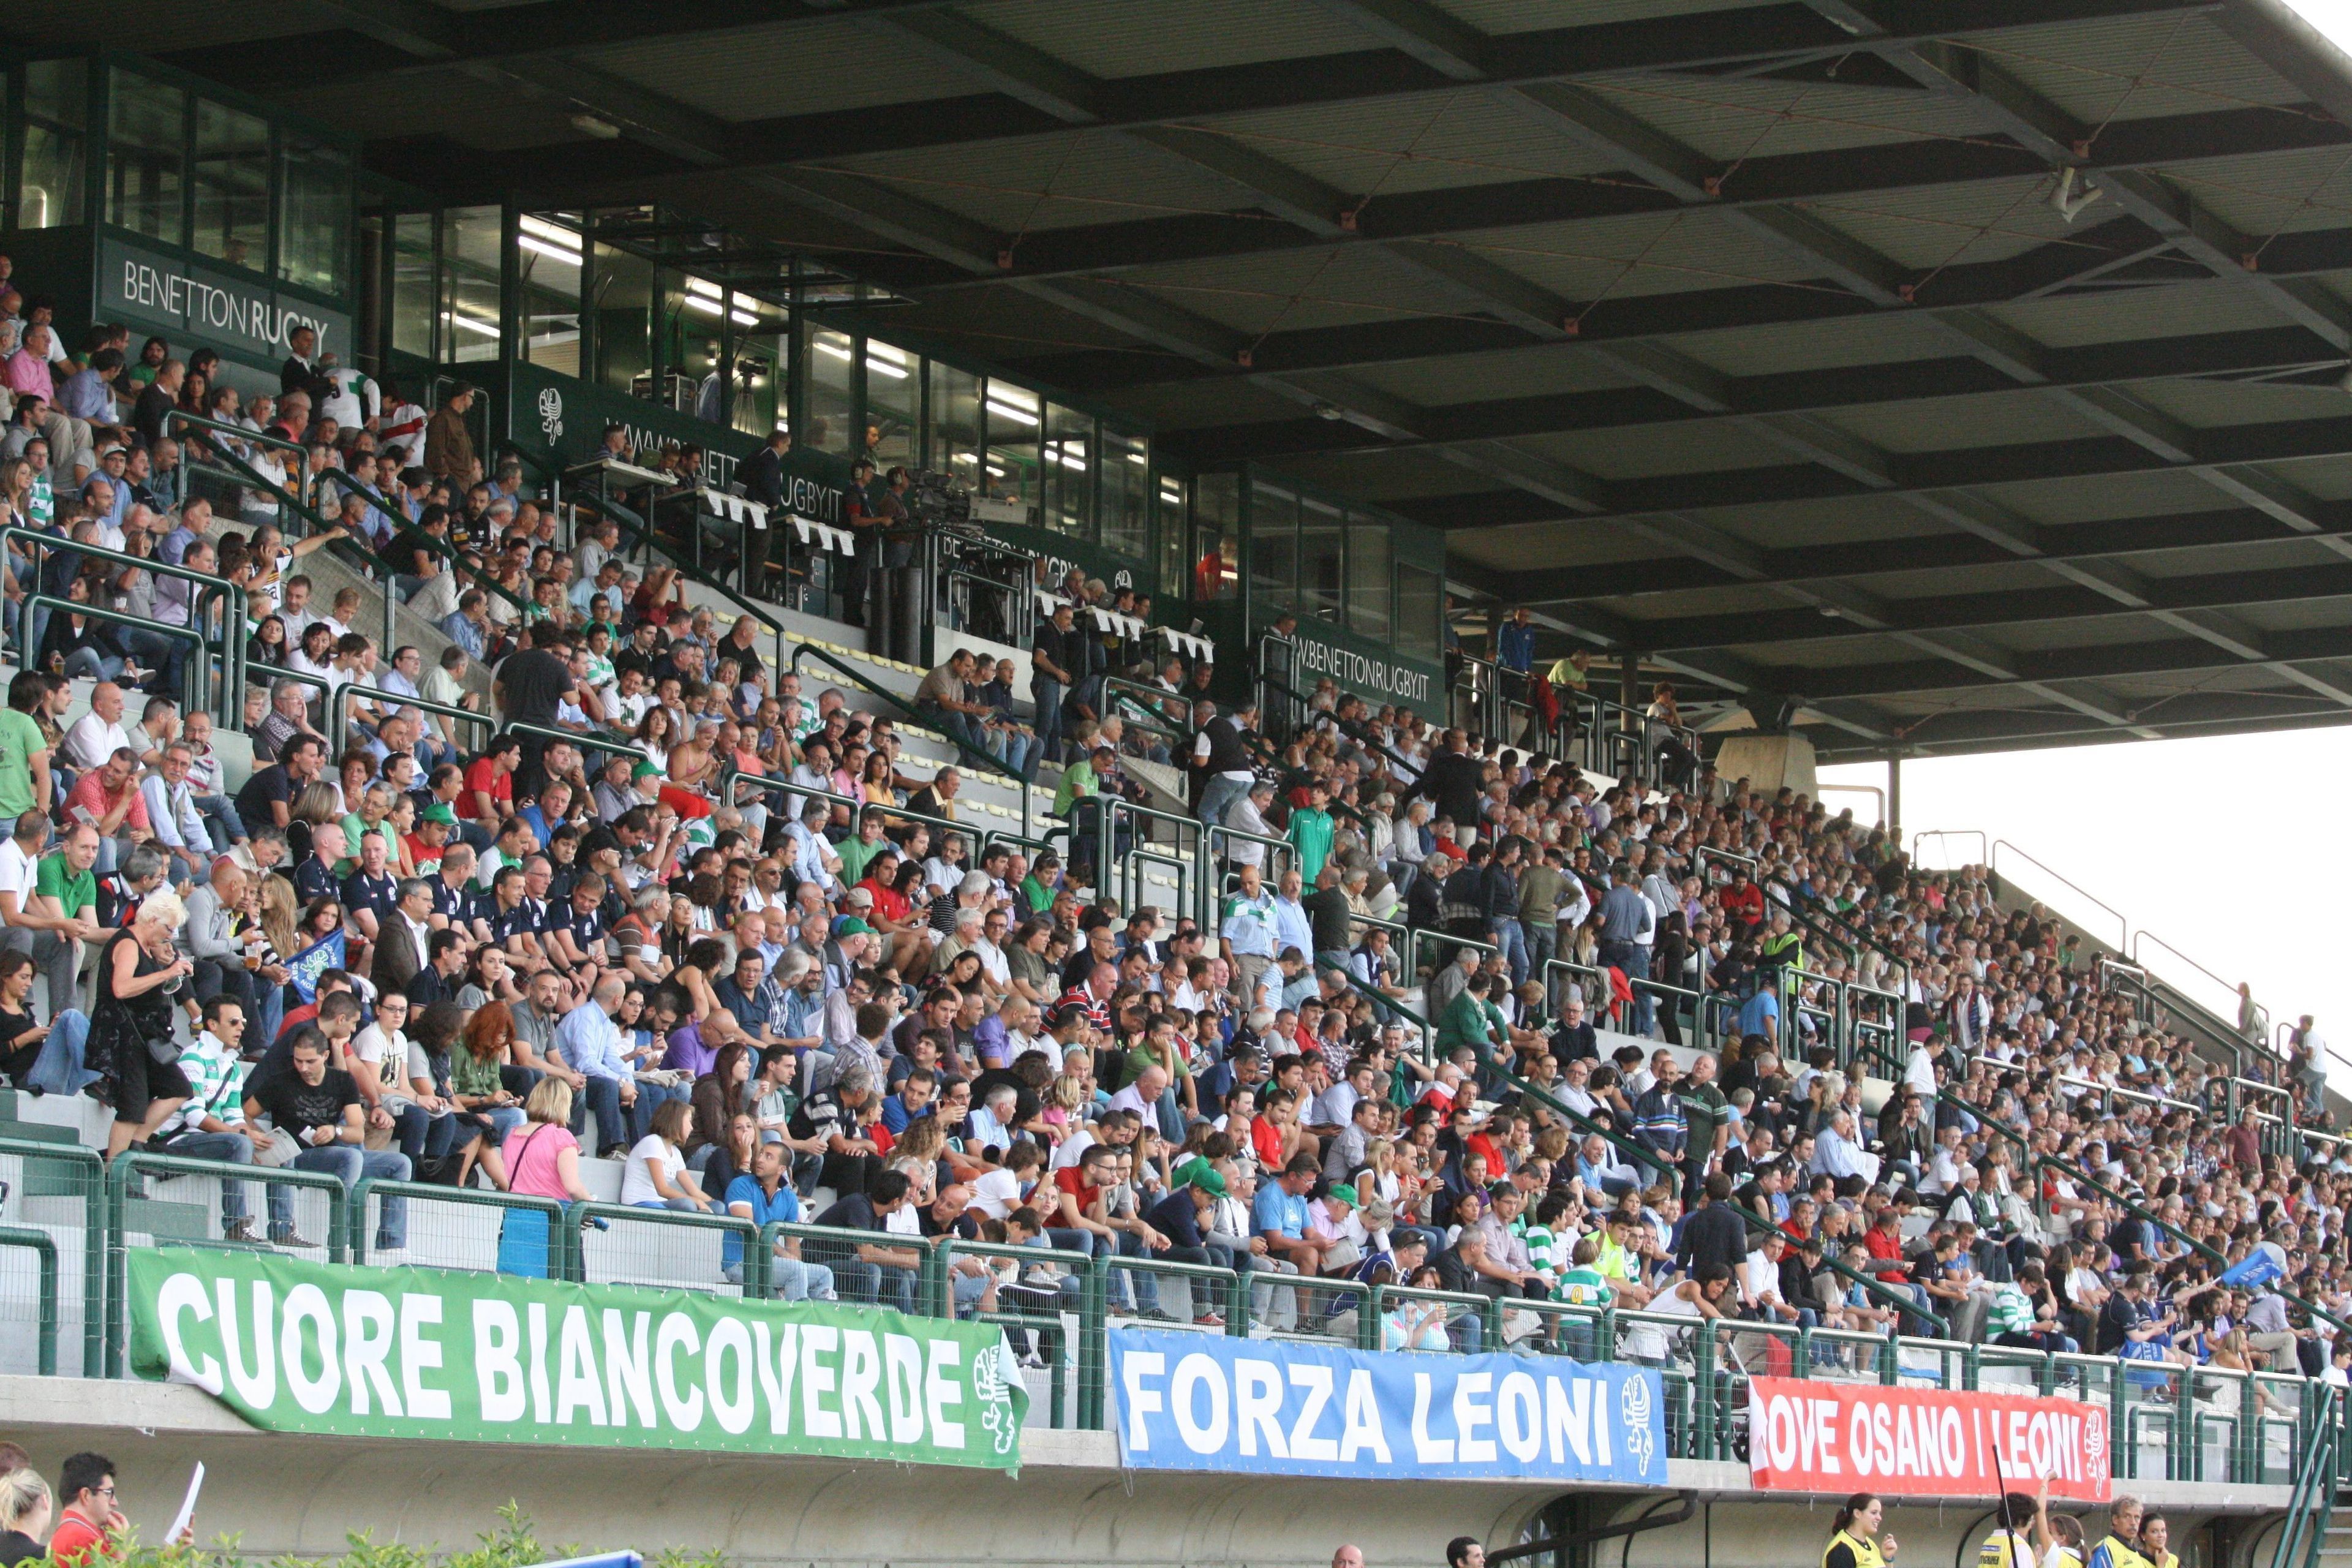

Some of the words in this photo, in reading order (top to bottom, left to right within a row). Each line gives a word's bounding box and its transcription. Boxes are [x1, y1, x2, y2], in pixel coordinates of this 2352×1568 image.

[124, 260, 246, 334] BENETTON
[1570, 1285, 1584, 1304] 9
[158, 1272, 452, 1419] CUORE
[472, 1298, 965, 1449] BIANCOVERDE
[1121, 1350, 1393, 1463] FORZA
[1411, 1371, 1611, 1466] LEONI
[1765, 1394, 1841, 1474] OVE
[1850, 1401, 1965, 1478] OSANO
[1973, 1408, 1985, 1477] I
[1991, 1409, 2082, 1482] LEONI
